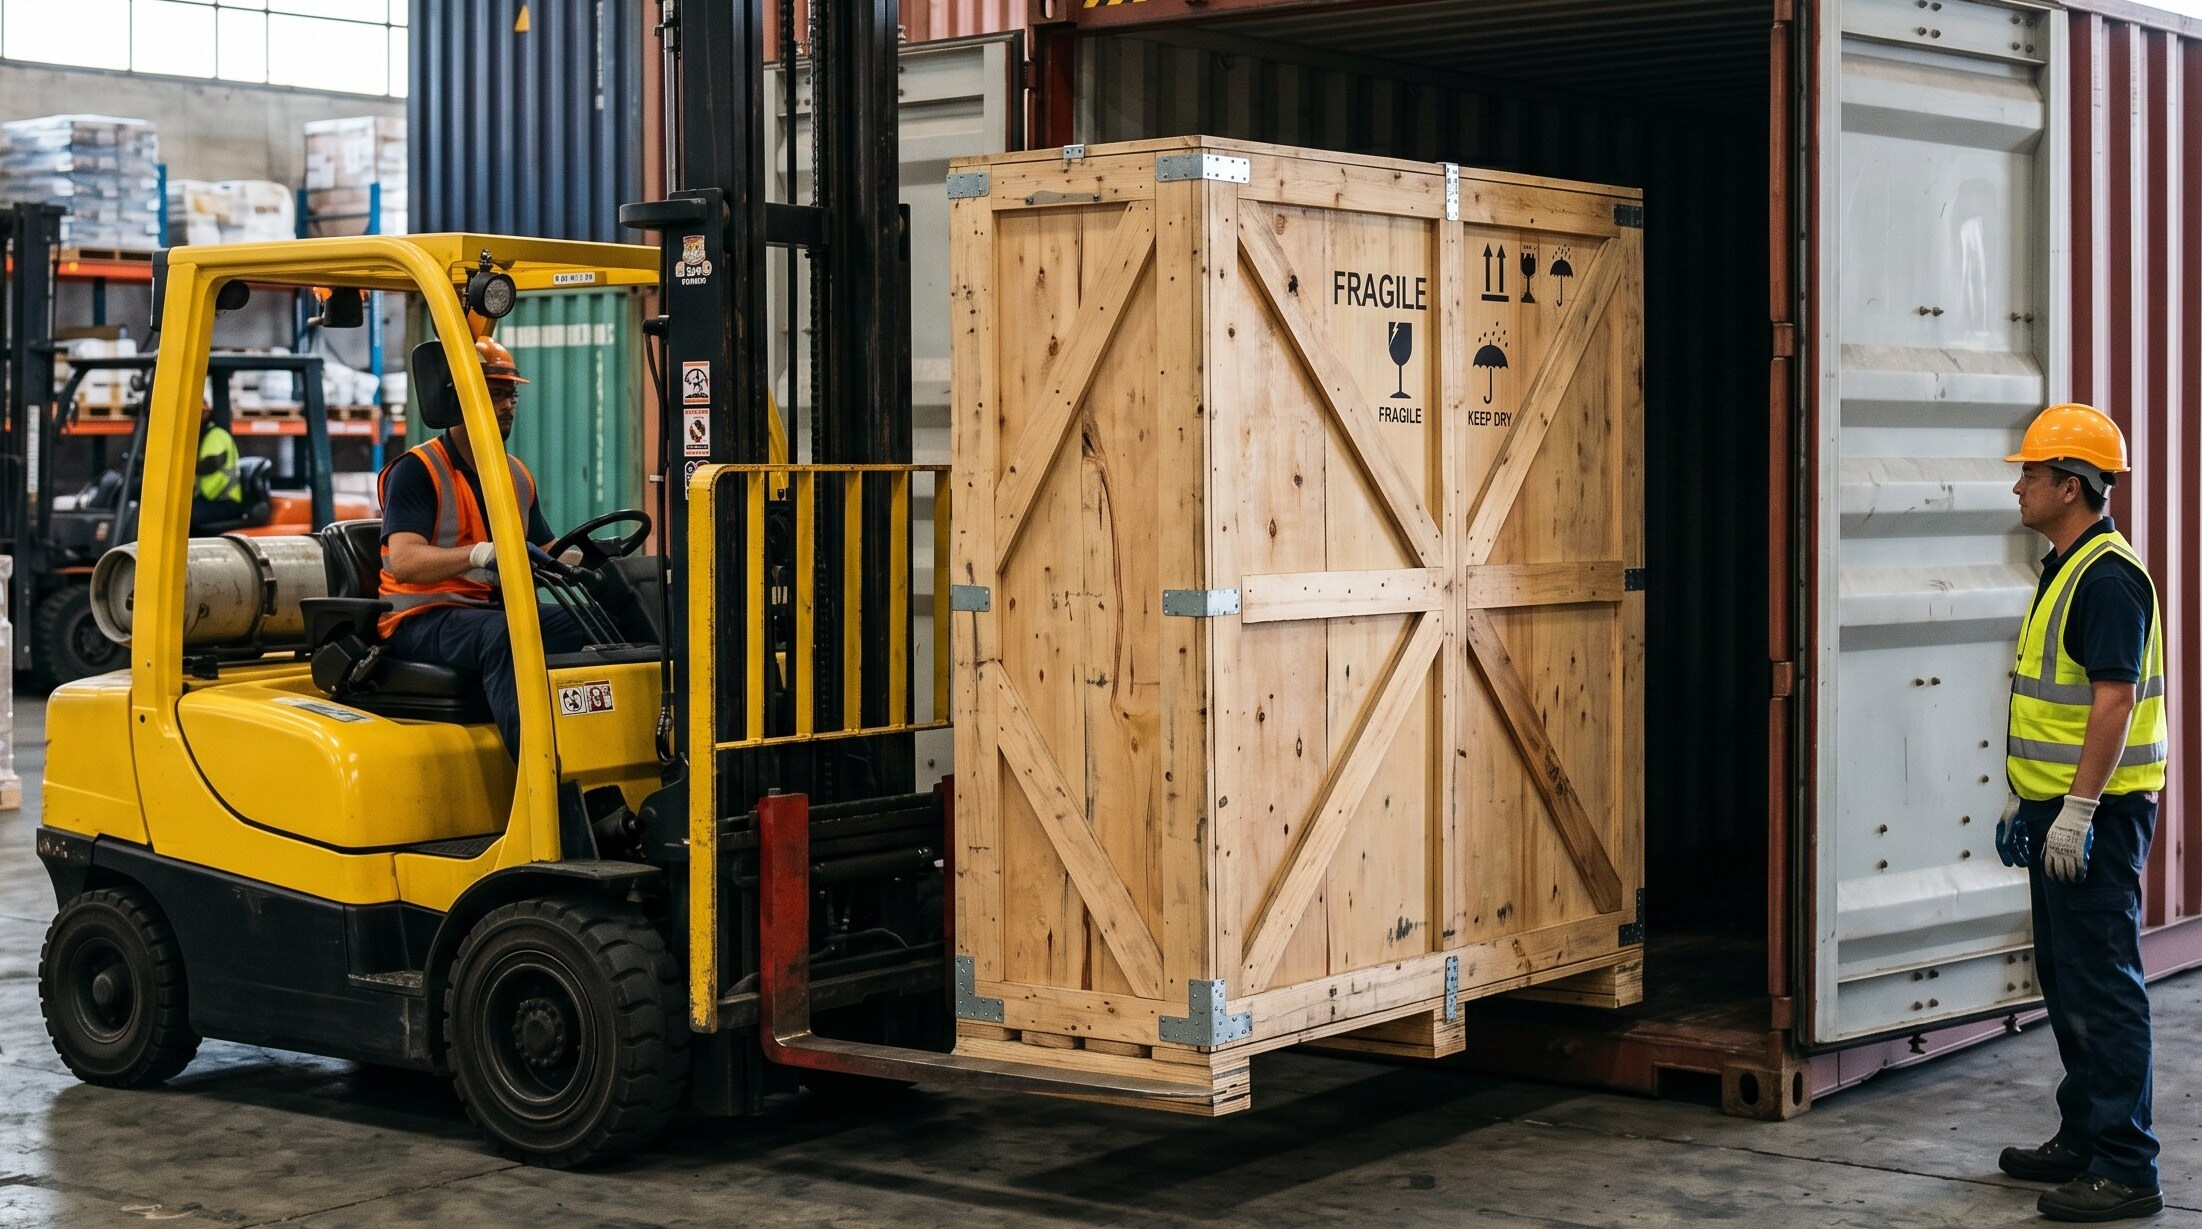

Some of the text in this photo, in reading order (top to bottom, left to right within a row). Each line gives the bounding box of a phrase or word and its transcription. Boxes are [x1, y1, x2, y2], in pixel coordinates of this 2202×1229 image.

[1334, 270, 1427, 311] FRAGILE
[1378, 406, 1422, 424] FRAGILE
[1467, 410, 1512, 427] KEEP DRY
